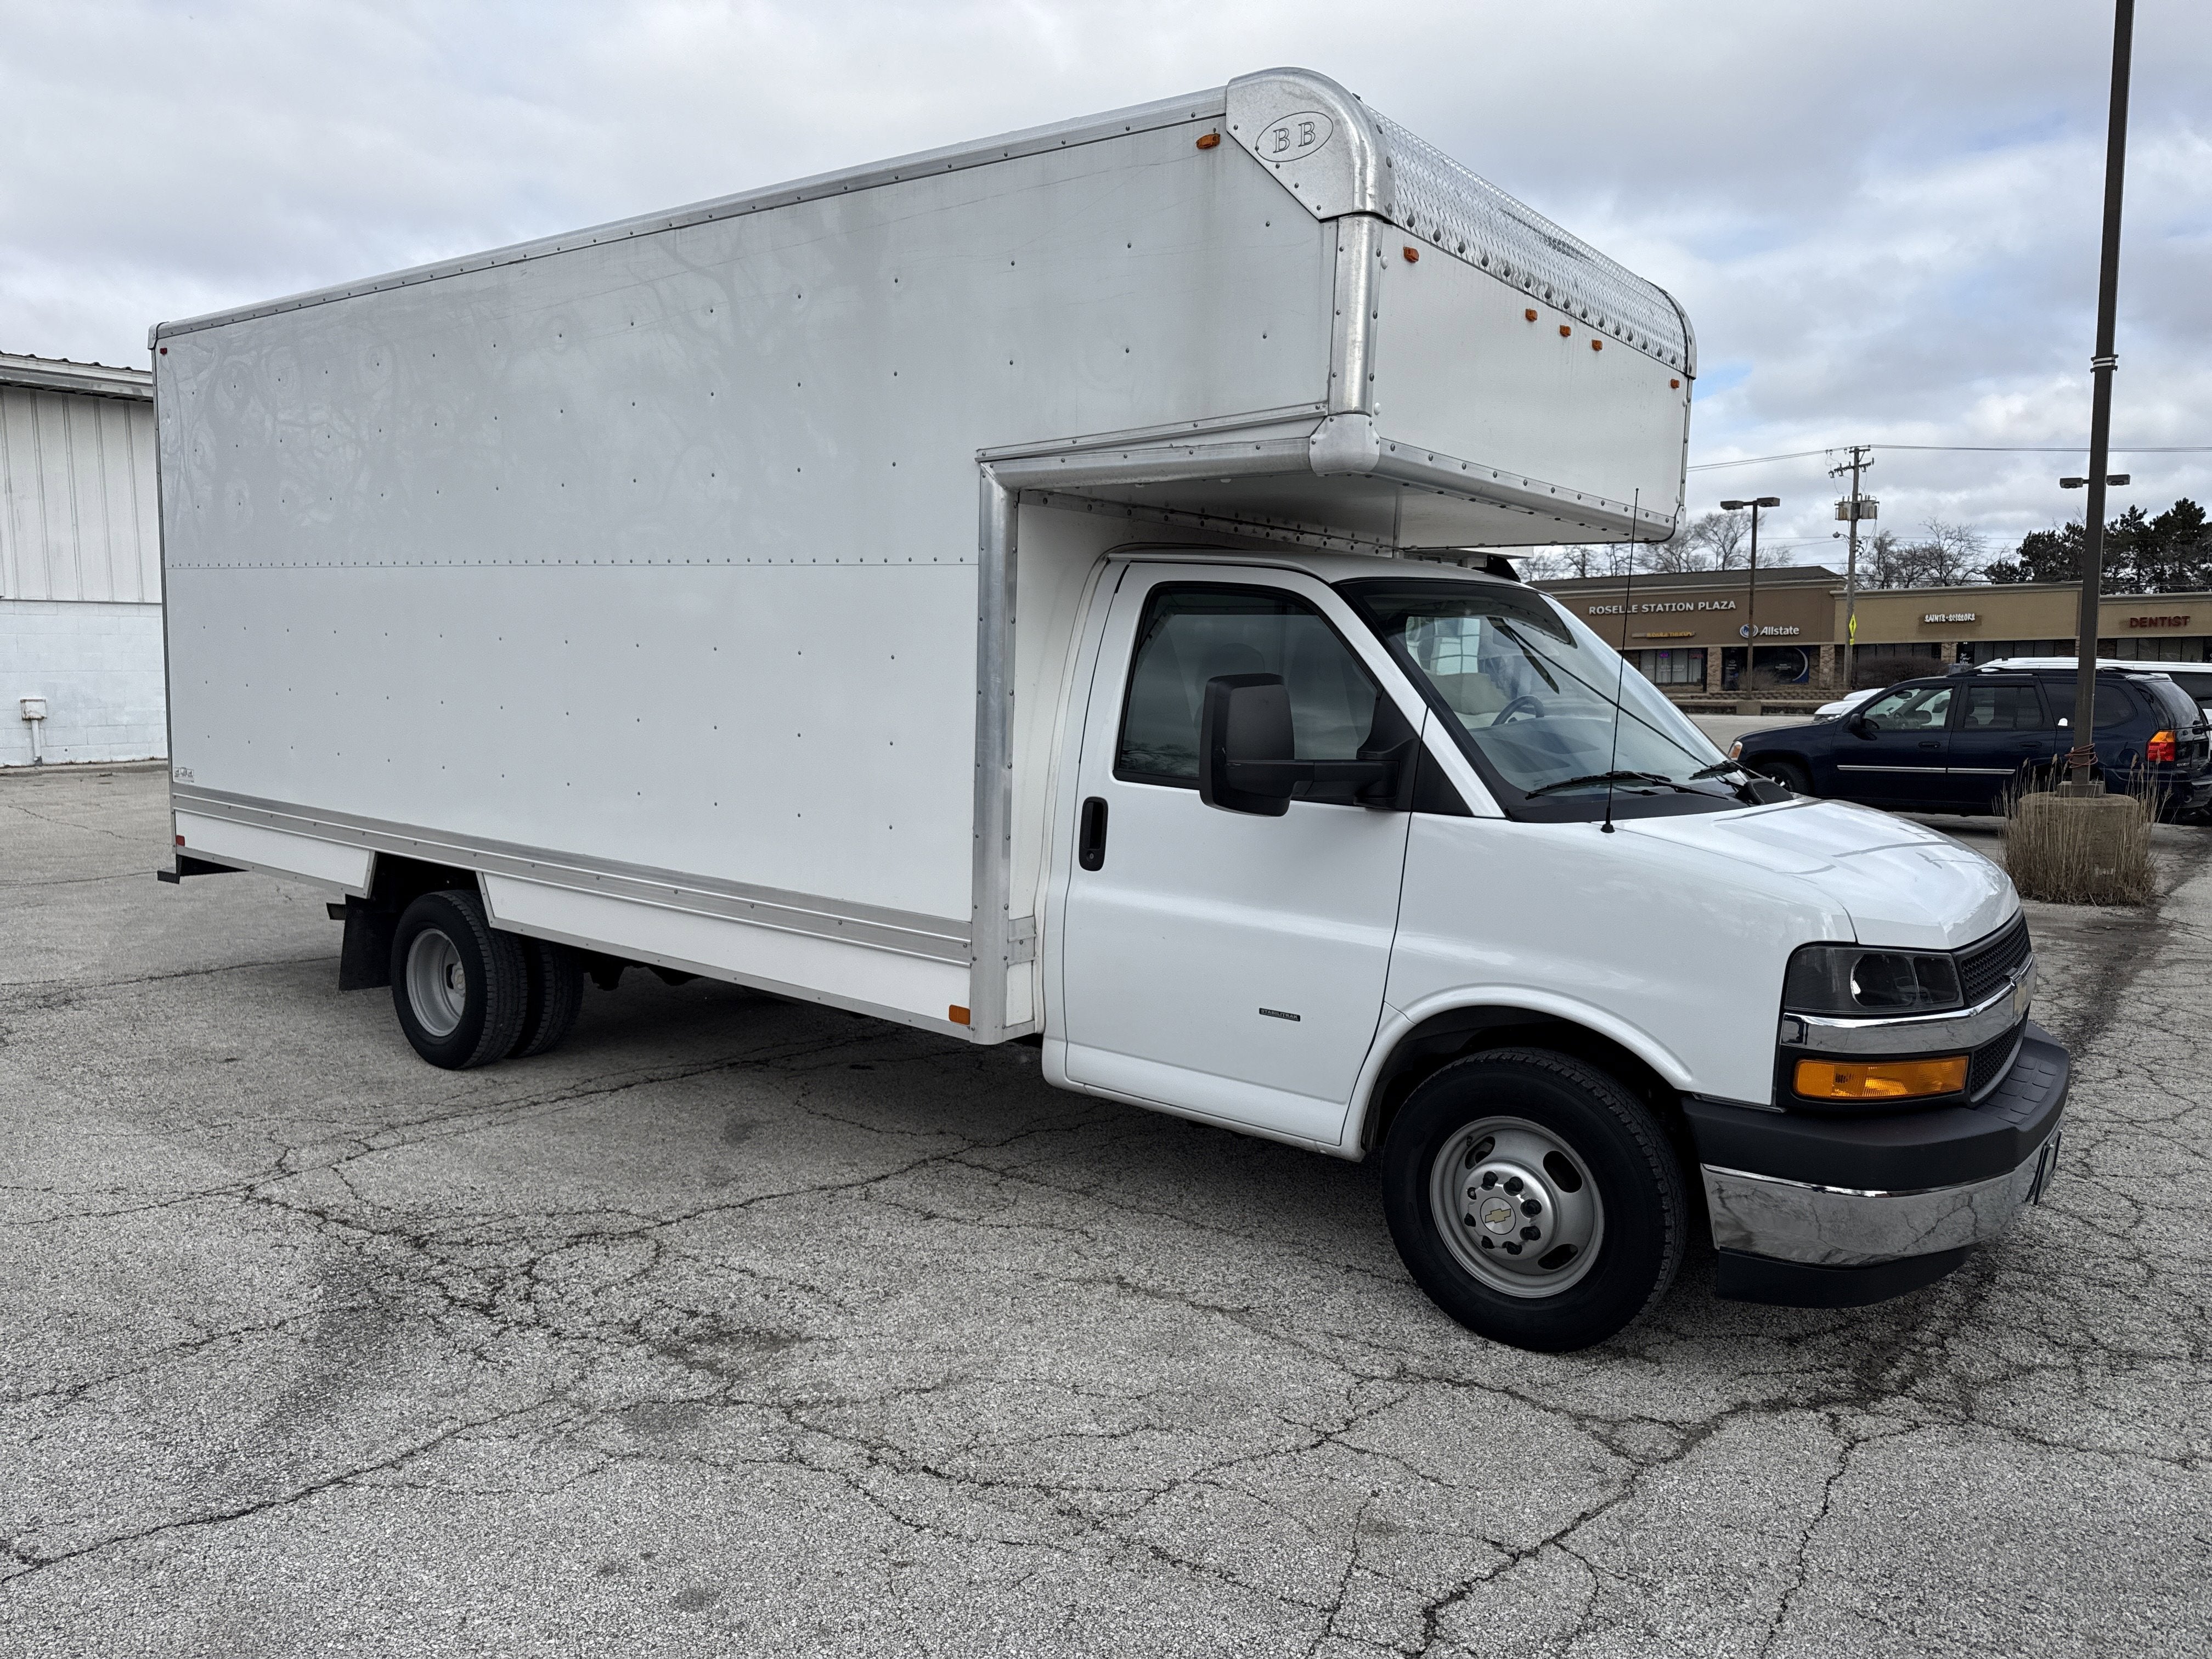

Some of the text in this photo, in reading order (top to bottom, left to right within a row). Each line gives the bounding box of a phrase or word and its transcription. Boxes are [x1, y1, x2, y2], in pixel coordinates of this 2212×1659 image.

[1641, 602, 1694, 612] STATION
[1698, 601, 1736, 611] PLAZA
[1924, 614, 1946, 623] SAINTS
[1948, 613, 1976, 622] SCISSORS
[2130, 616, 2191, 628] DENTIST
[1759, 626, 1799, 636] Allstate
[1261, 1009, 1298, 1019] STABILITRAK
